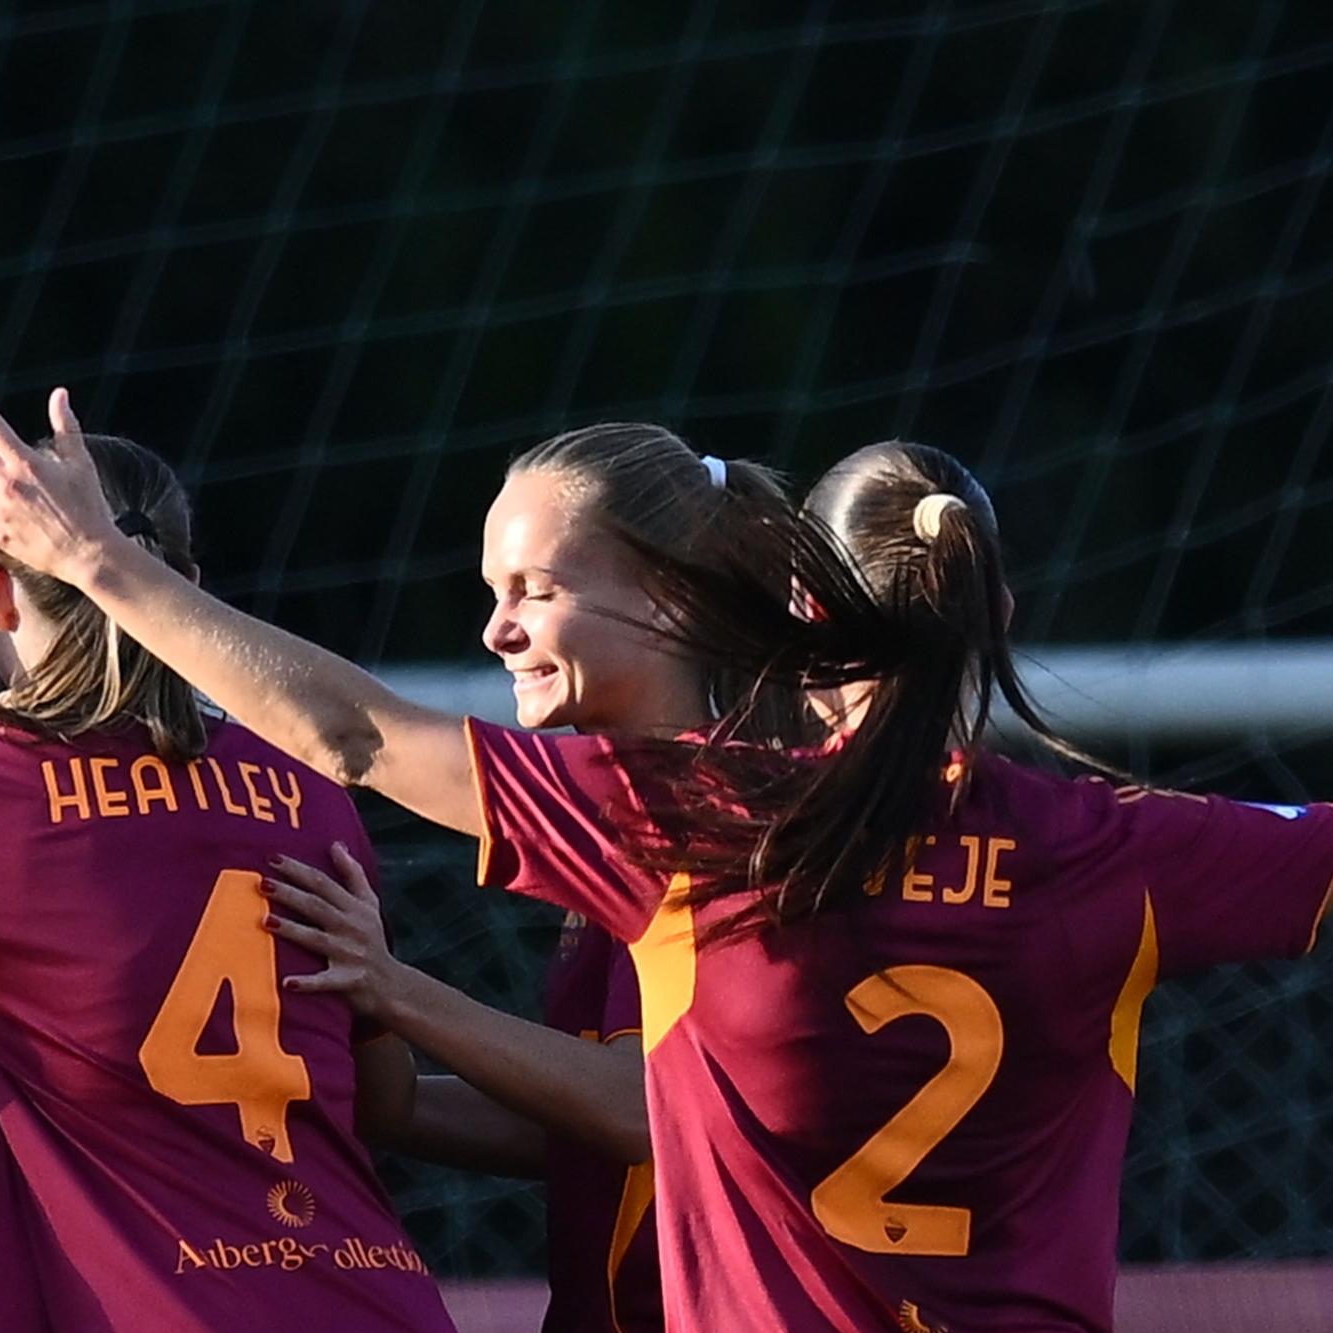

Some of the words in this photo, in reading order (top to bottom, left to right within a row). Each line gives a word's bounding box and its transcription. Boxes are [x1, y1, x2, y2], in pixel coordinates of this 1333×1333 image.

[41, 755, 301, 829] HEATLEY
[138, 868, 312, 1165] 4
[810, 964, 1004, 1258] 2
